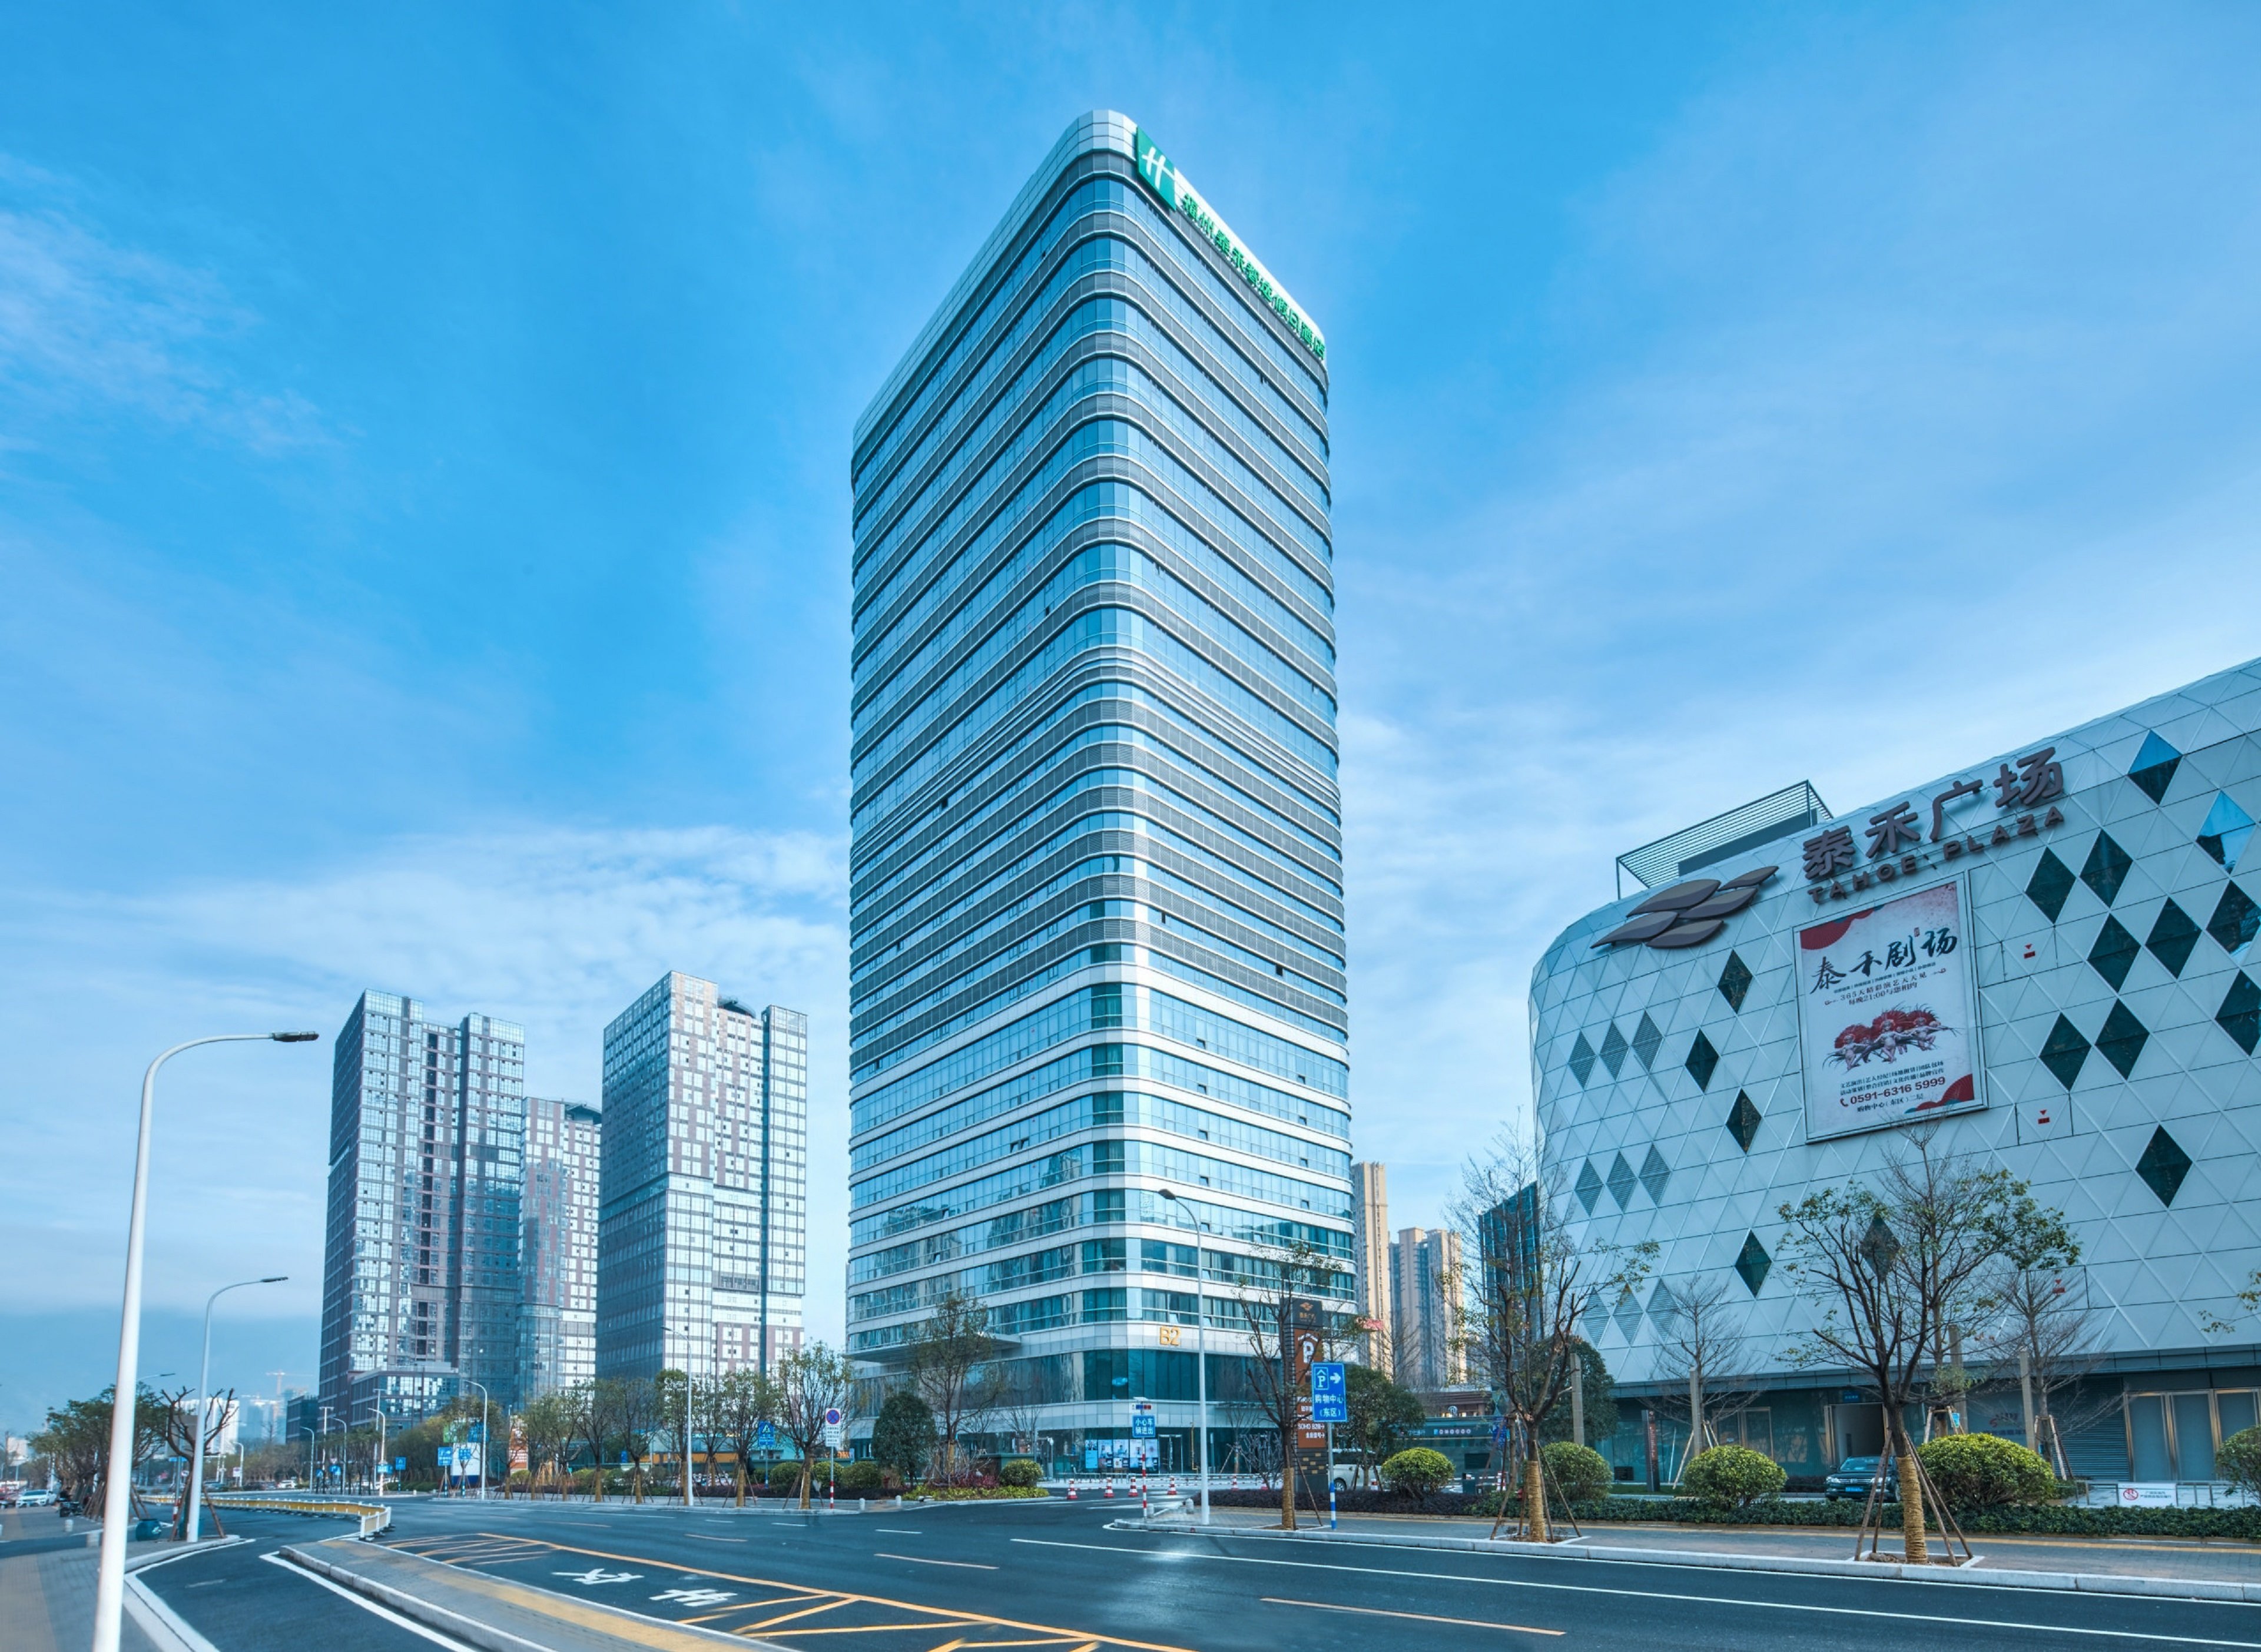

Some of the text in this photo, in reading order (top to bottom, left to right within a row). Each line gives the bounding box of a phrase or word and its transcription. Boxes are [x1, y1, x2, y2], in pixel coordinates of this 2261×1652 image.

[1182, 193, 1325, 360] 福州泰禾智选假日酒店
[1802, 747, 2064, 880] 泰禾广场
[1808, 806, 2064, 904] TAHOE PLAZA
[1809, 927, 1958, 994] 泰禾剧场
[1850, 1076, 1946, 1104] 0591-6316 5999
[1159, 1326, 1181, 1346] B2
[1318, 1375, 1326, 1388] P
[1315, 1394, 1344, 1404] 购物中心
[1135, 1418, 1153, 1427] 小心车
